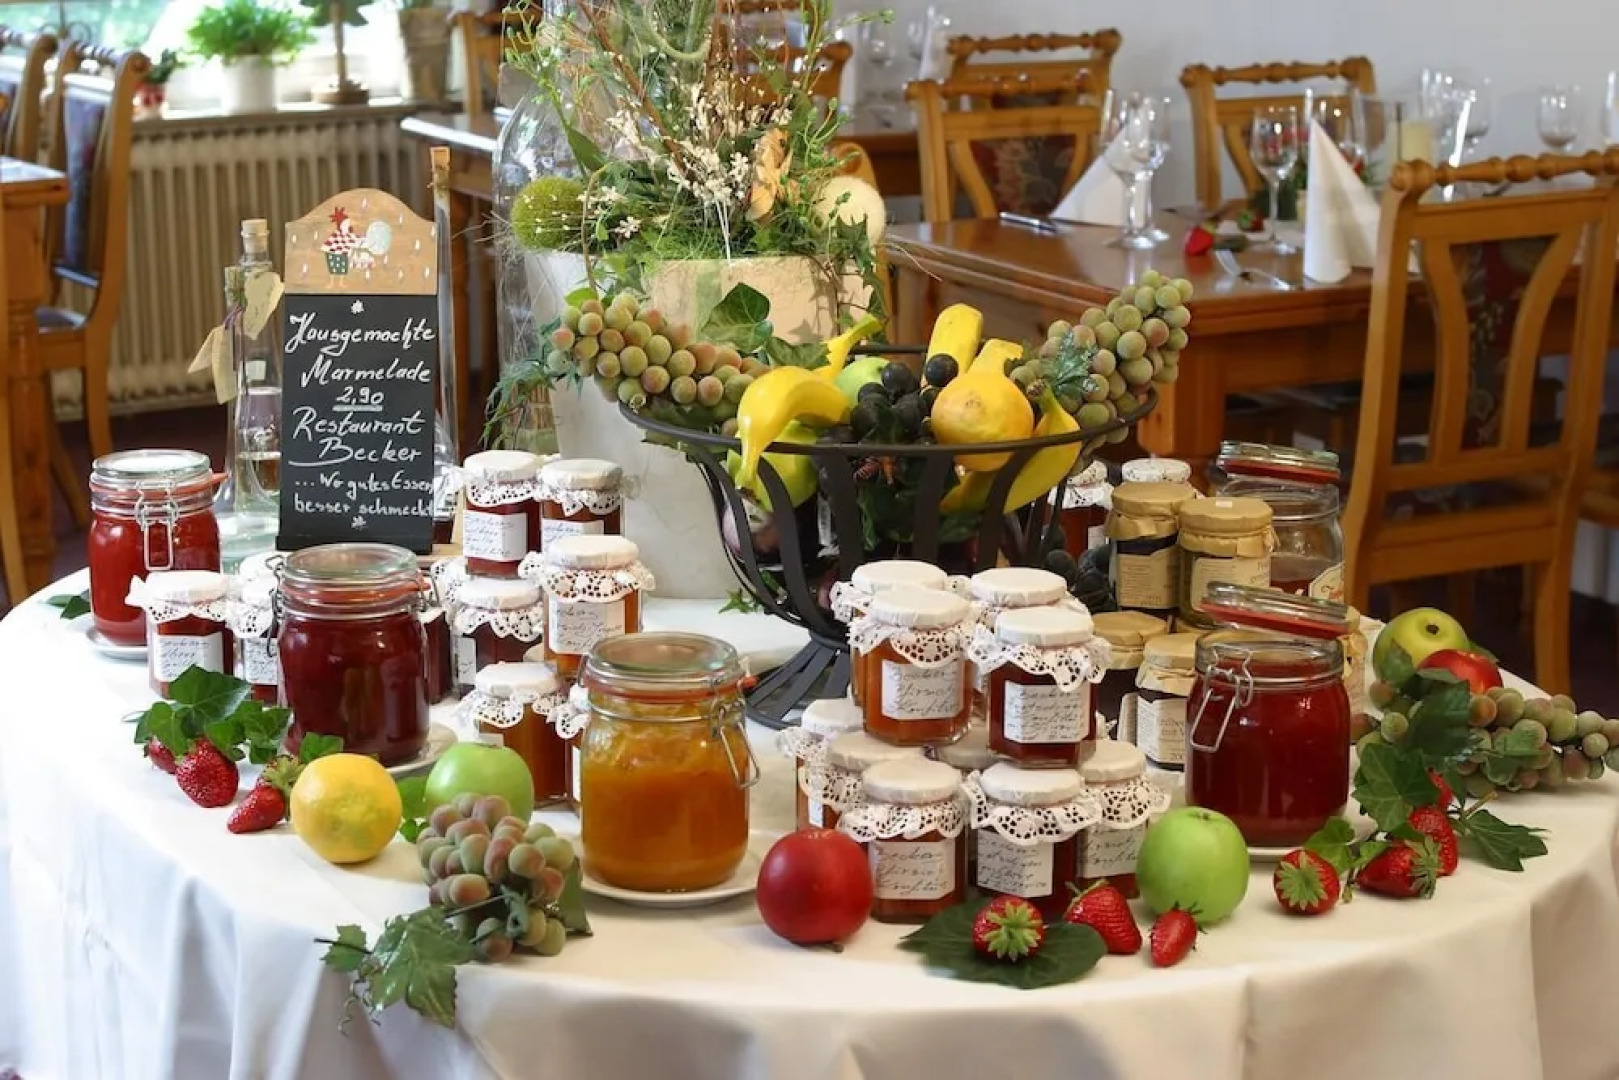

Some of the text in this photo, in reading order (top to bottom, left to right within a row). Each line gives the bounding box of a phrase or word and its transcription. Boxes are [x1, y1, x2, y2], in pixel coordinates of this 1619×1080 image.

[300, 354, 431, 388] Marmelade
[336, 386, 384, 405] 2,90
[292, 405, 426, 442] Restaurant
[288, 437, 422, 467] Becker
[320, 470, 344, 488] Wo
[346, 472, 390, 500] gutes
[391, 469, 434, 495] Essen
[294, 492, 351, 513] besser
